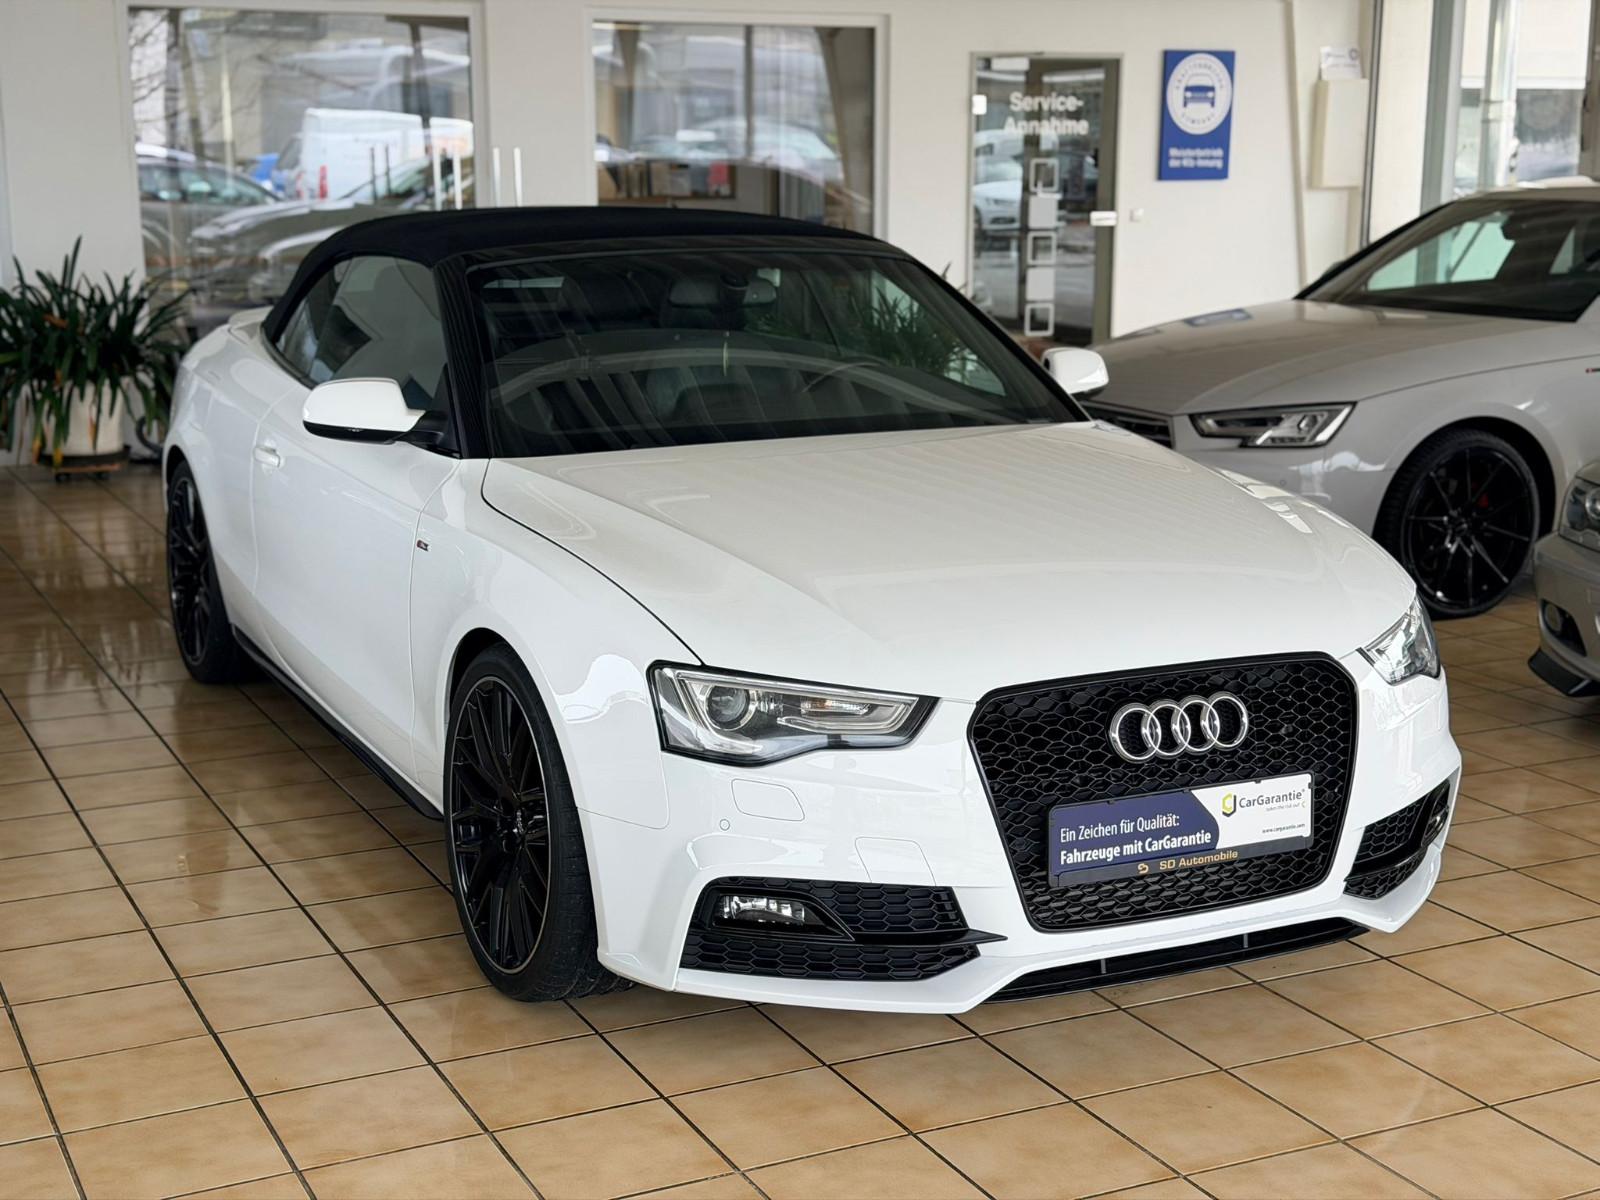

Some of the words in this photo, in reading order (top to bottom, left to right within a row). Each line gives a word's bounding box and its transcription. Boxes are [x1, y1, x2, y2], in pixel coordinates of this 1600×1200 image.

[1009, 91, 1084, 112] Service-
[1004, 116, 1089, 136] Annahme
[1239, 789, 1303, 808] CarGarantie
[1060, 828, 1076, 843] Ein
[1078, 823, 1118, 840] Zeichen
[1120, 820, 1135, 834] für
[1136, 813, 1180, 831] Qualität:
[1060, 844, 1121, 865] Fahrzeuge
[1122, 840, 1143, 856] mit
[1145, 829, 1212, 851] CarGarantie
[1159, 859, 1176, 870] SD
[1178, 851, 1239, 868] Automobile
